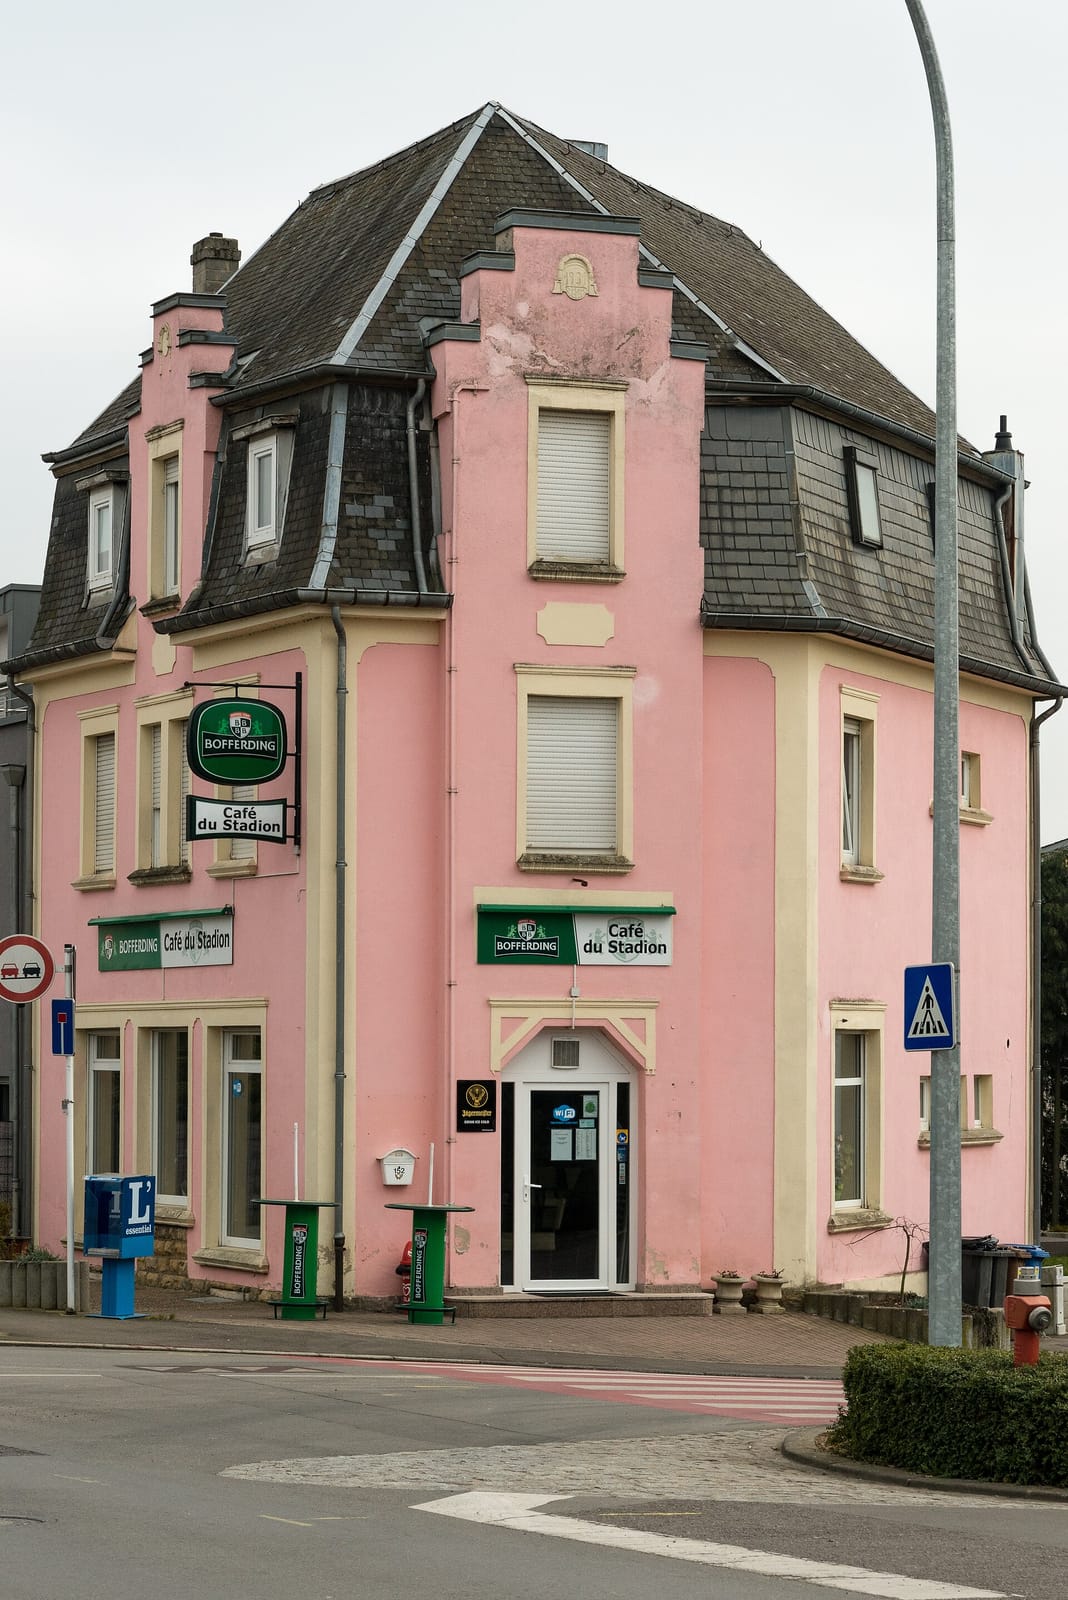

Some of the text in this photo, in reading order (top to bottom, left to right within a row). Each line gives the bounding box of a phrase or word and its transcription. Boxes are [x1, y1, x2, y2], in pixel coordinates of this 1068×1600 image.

[205, 738, 276, 751] BOFFERDING
[223, 806, 257, 819] Café
[197, 818, 281, 833] du Stadion
[608, 922, 643, 938] Café
[119, 929, 230, 954] BOFFERDING Café du Stadion
[496, 941, 557, 951] BOFFERDING
[583, 939, 667, 954] du Stadion
[394, 1167, 405, 1175] 152
[125, 1224, 152, 1235] essentiel
[294, 1245, 303, 1293] BOFFERDING
